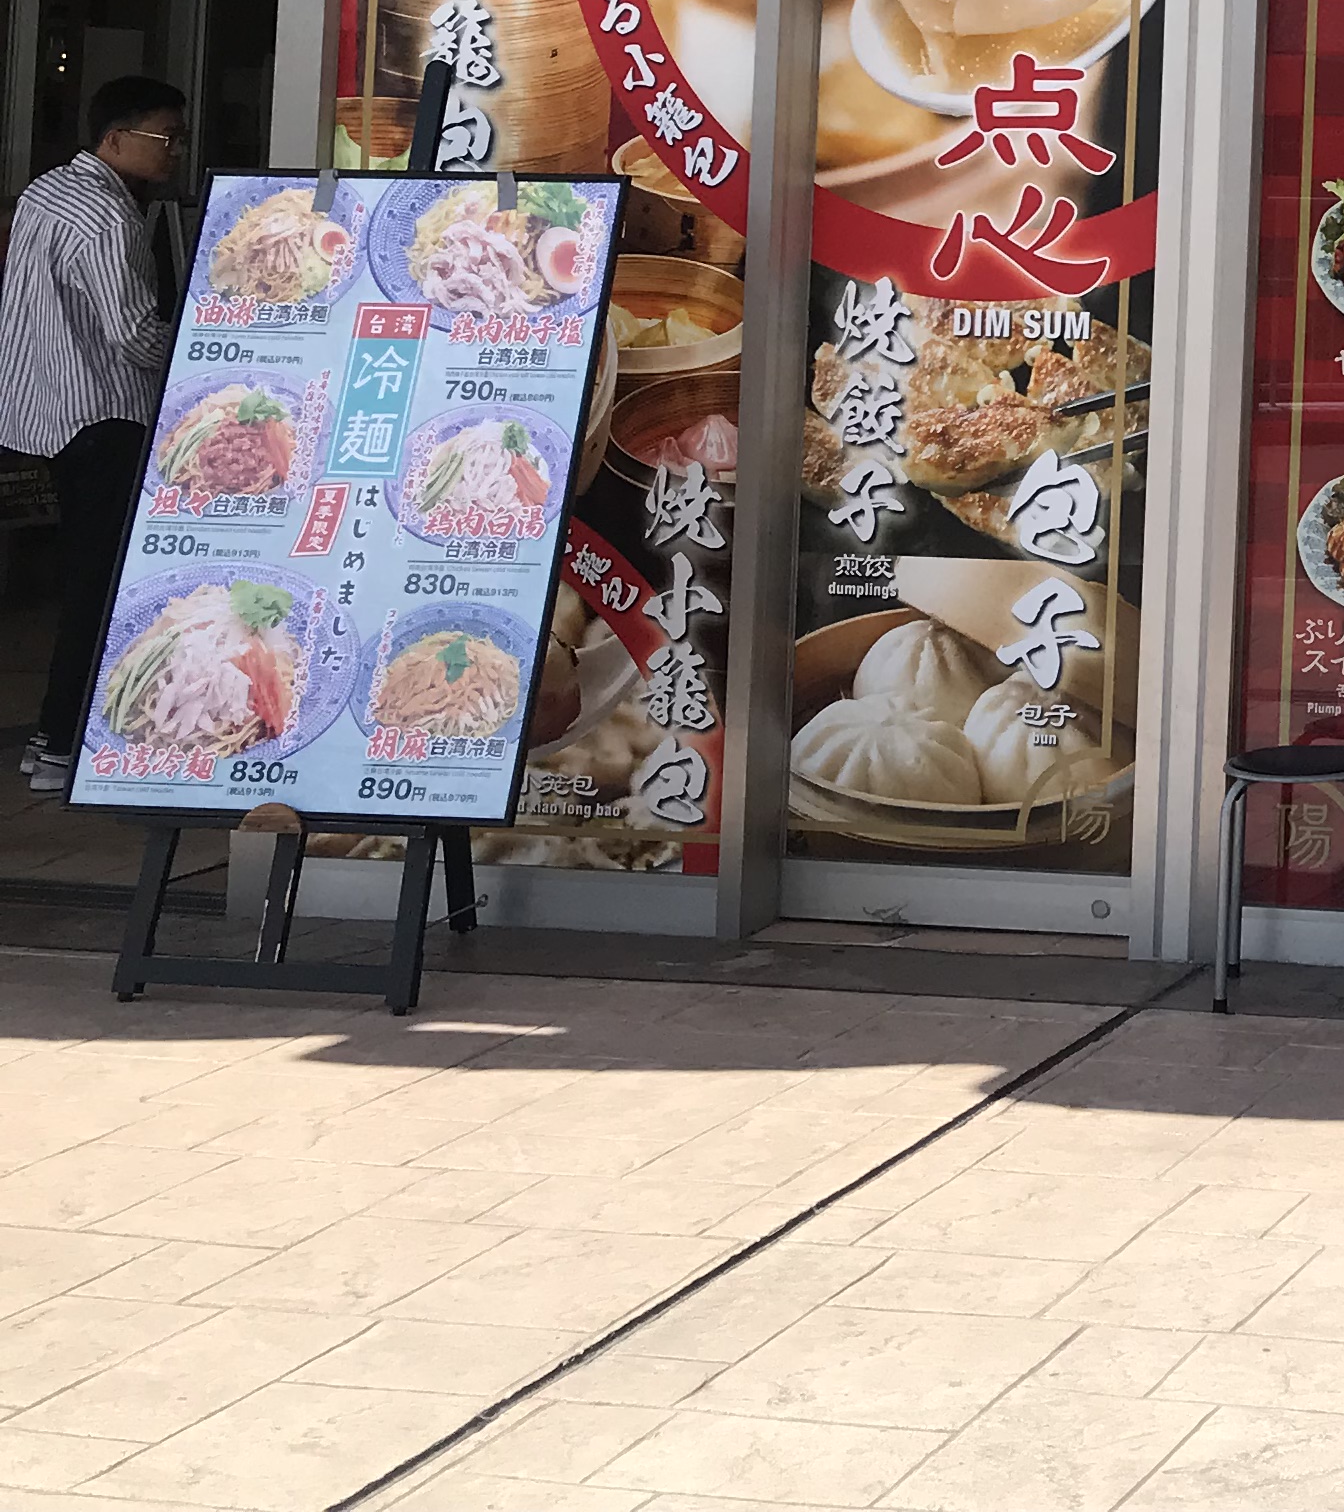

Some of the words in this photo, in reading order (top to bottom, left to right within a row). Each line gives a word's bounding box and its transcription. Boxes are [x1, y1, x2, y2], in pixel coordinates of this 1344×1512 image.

[930, 52, 1118, 298] 点心
[368, 314, 418, 335] 台湾
[952, 306, 1012, 339] DIM
[1023, 308, 1092, 341] SUM
[187, 341, 254, 364] 890円
[444, 379, 508, 402] 790円
[141, 533, 210, 557] 830円
[321, 485, 379, 672] はじめました
[997, 448, 1101, 690] 包子
[403, 572, 470, 597] 830円
[827, 580, 898, 601] dumplings
[1014, 701, 1077, 728] 包子
[1306, 702, 1342, 716] Plump
[1030, 729, 1058, 748] bun
[229, 760, 299, 785] 830円
[357, 776, 427, 801] 890円
[562, 801, 592, 819] long
[595, 802, 621, 818] bao
